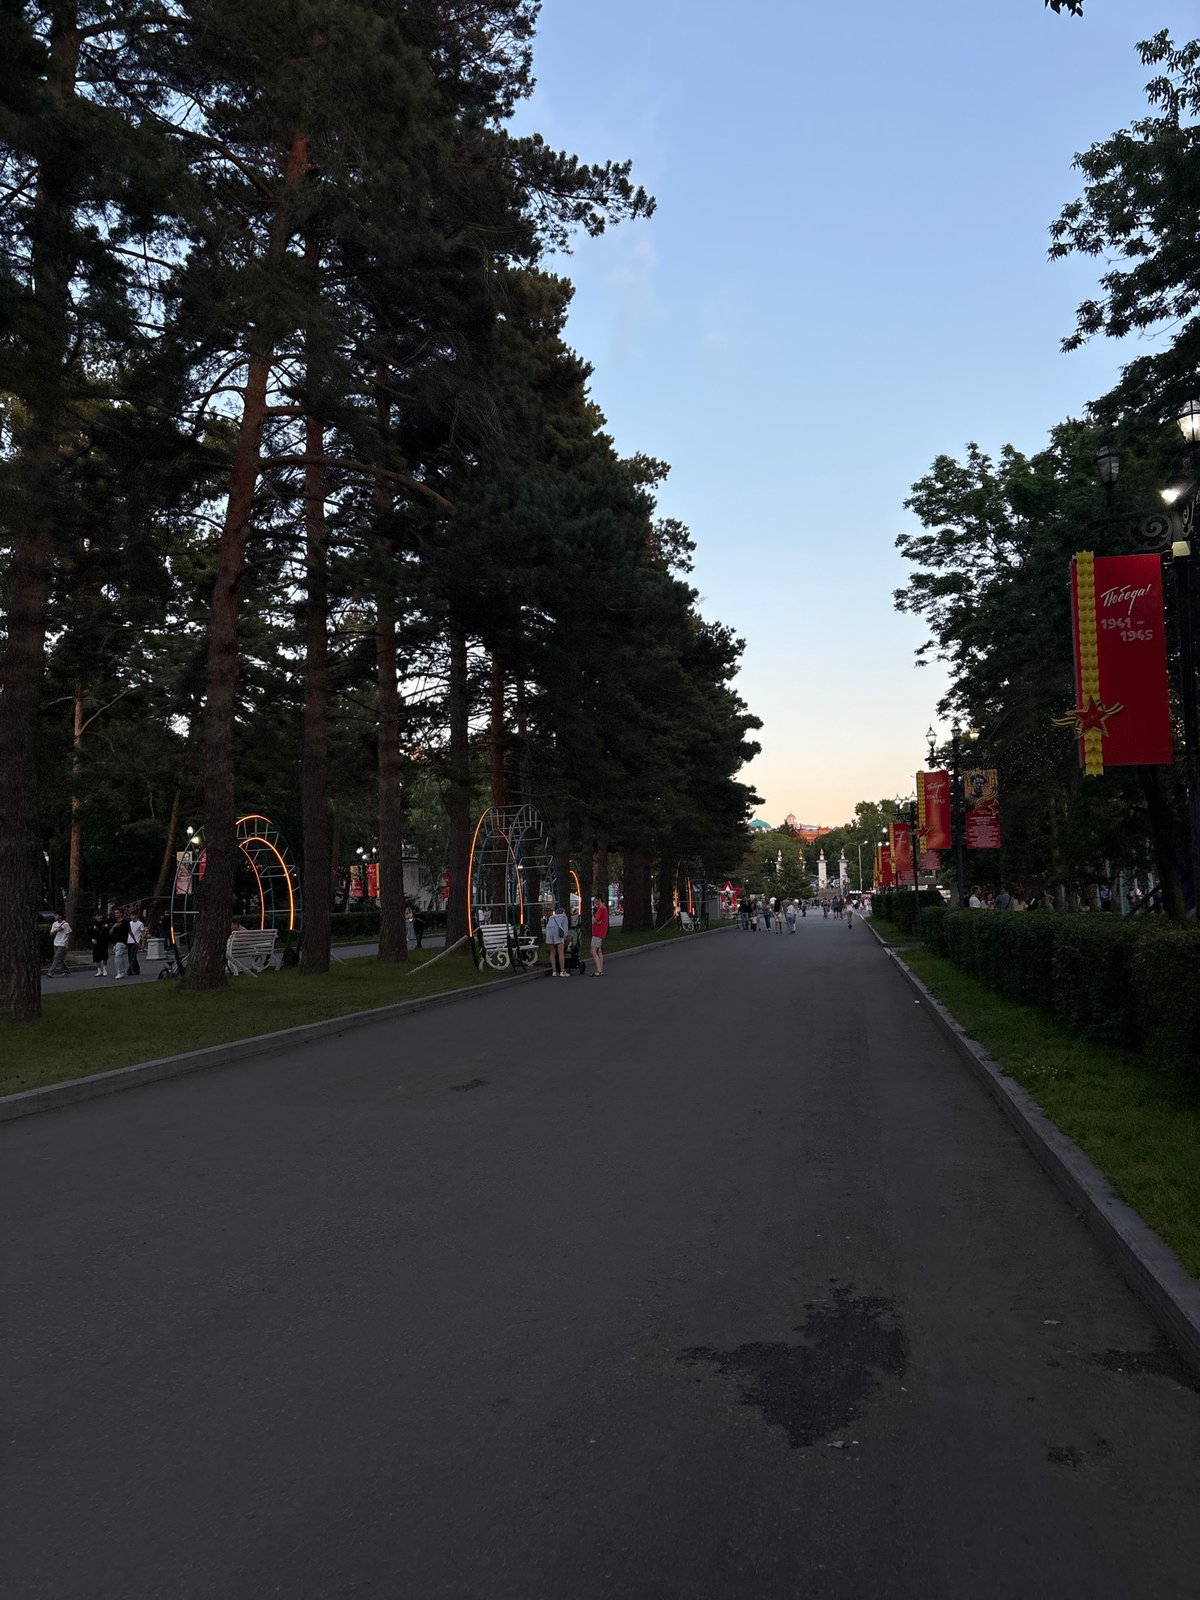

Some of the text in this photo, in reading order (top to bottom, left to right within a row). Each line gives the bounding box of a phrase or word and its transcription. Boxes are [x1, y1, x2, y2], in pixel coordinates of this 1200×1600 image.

[1101, 584, 1151, 615] Победа!
[1101, 617, 1131, 629] 1941
[1120, 629, 1153, 641] 1945
